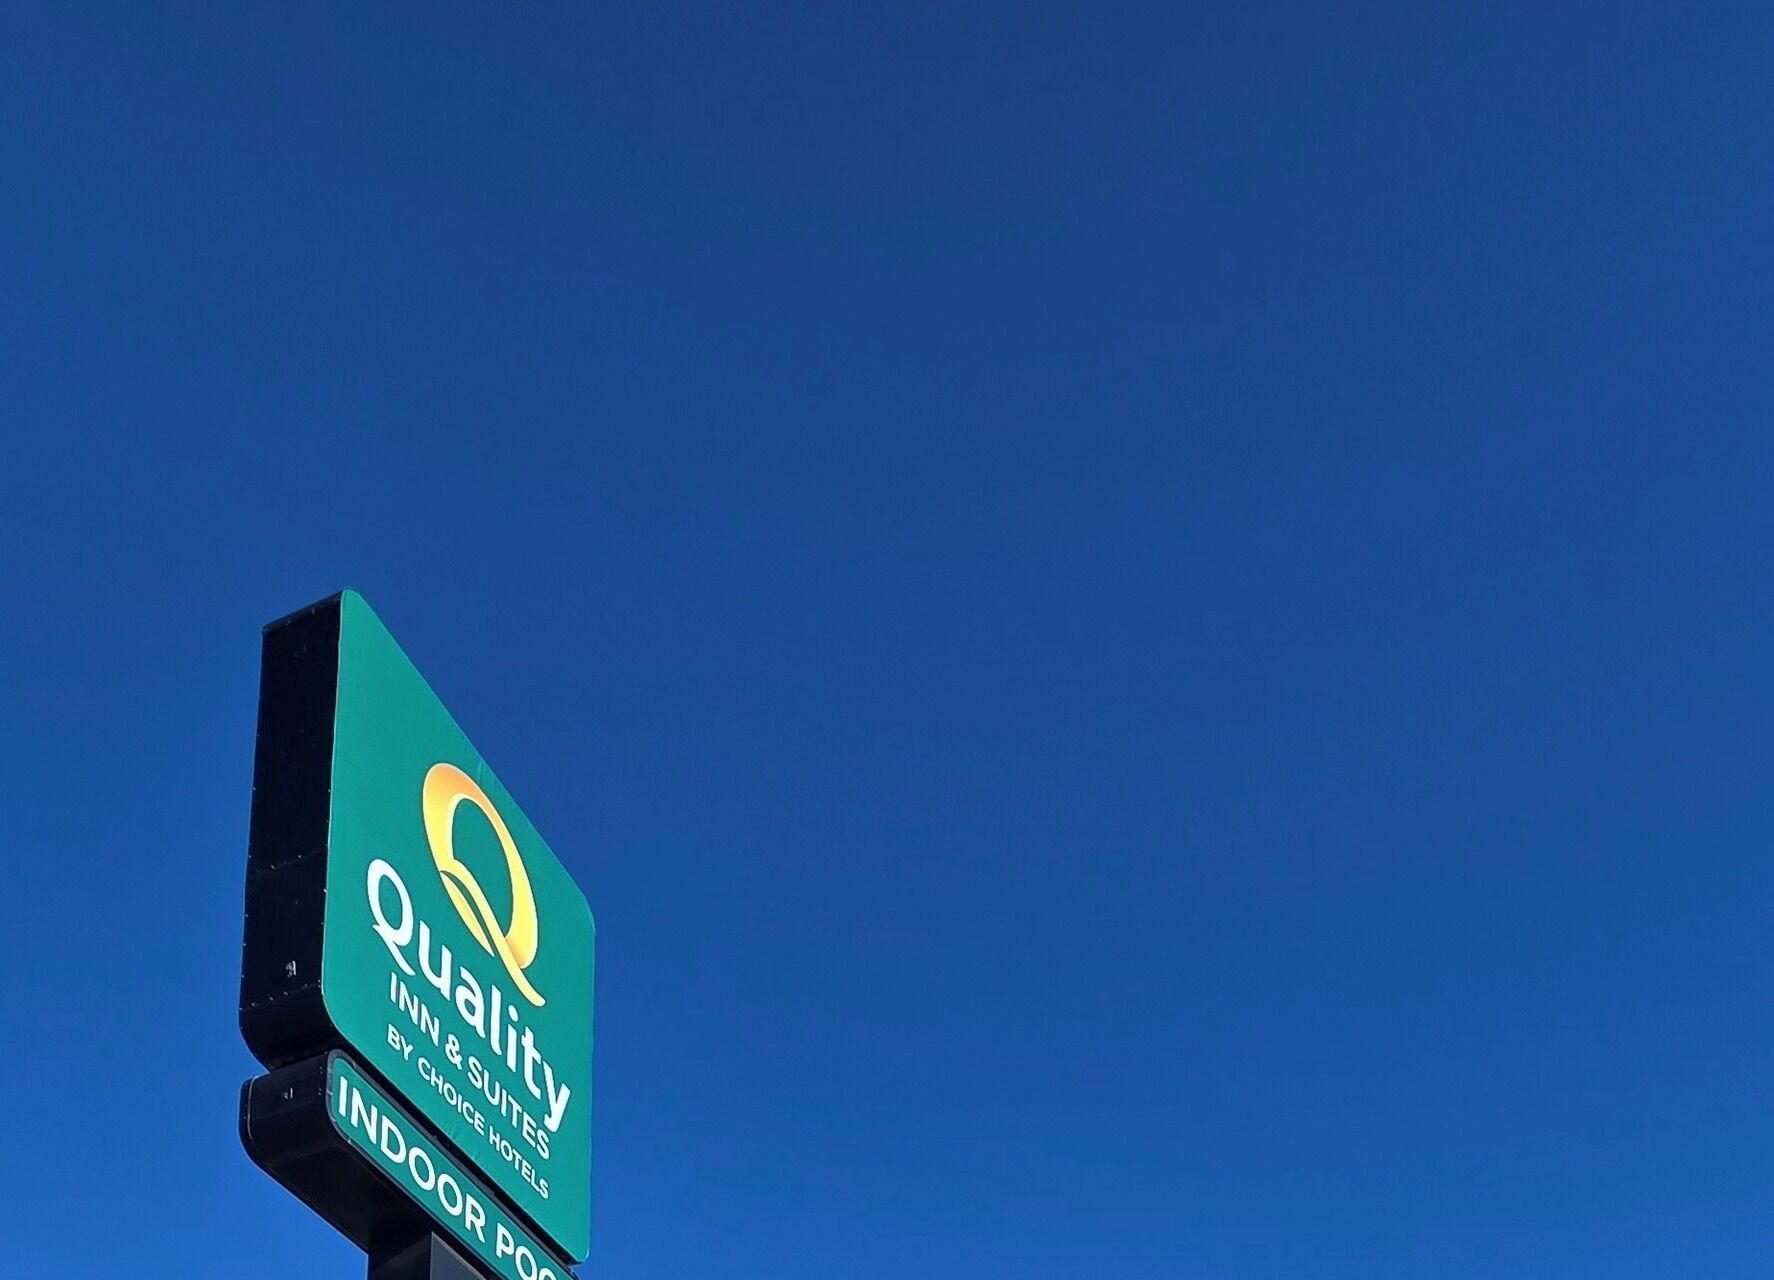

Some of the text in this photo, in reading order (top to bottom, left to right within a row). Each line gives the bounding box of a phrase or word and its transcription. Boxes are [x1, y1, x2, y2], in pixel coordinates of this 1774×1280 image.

[366, 857, 571, 1133] Quality
[389, 970, 550, 1160] INN & SUITES
[338, 1075, 486, 1243] INDOOR
[387, 1023, 550, 1200] BY CHOICE HOTELS
